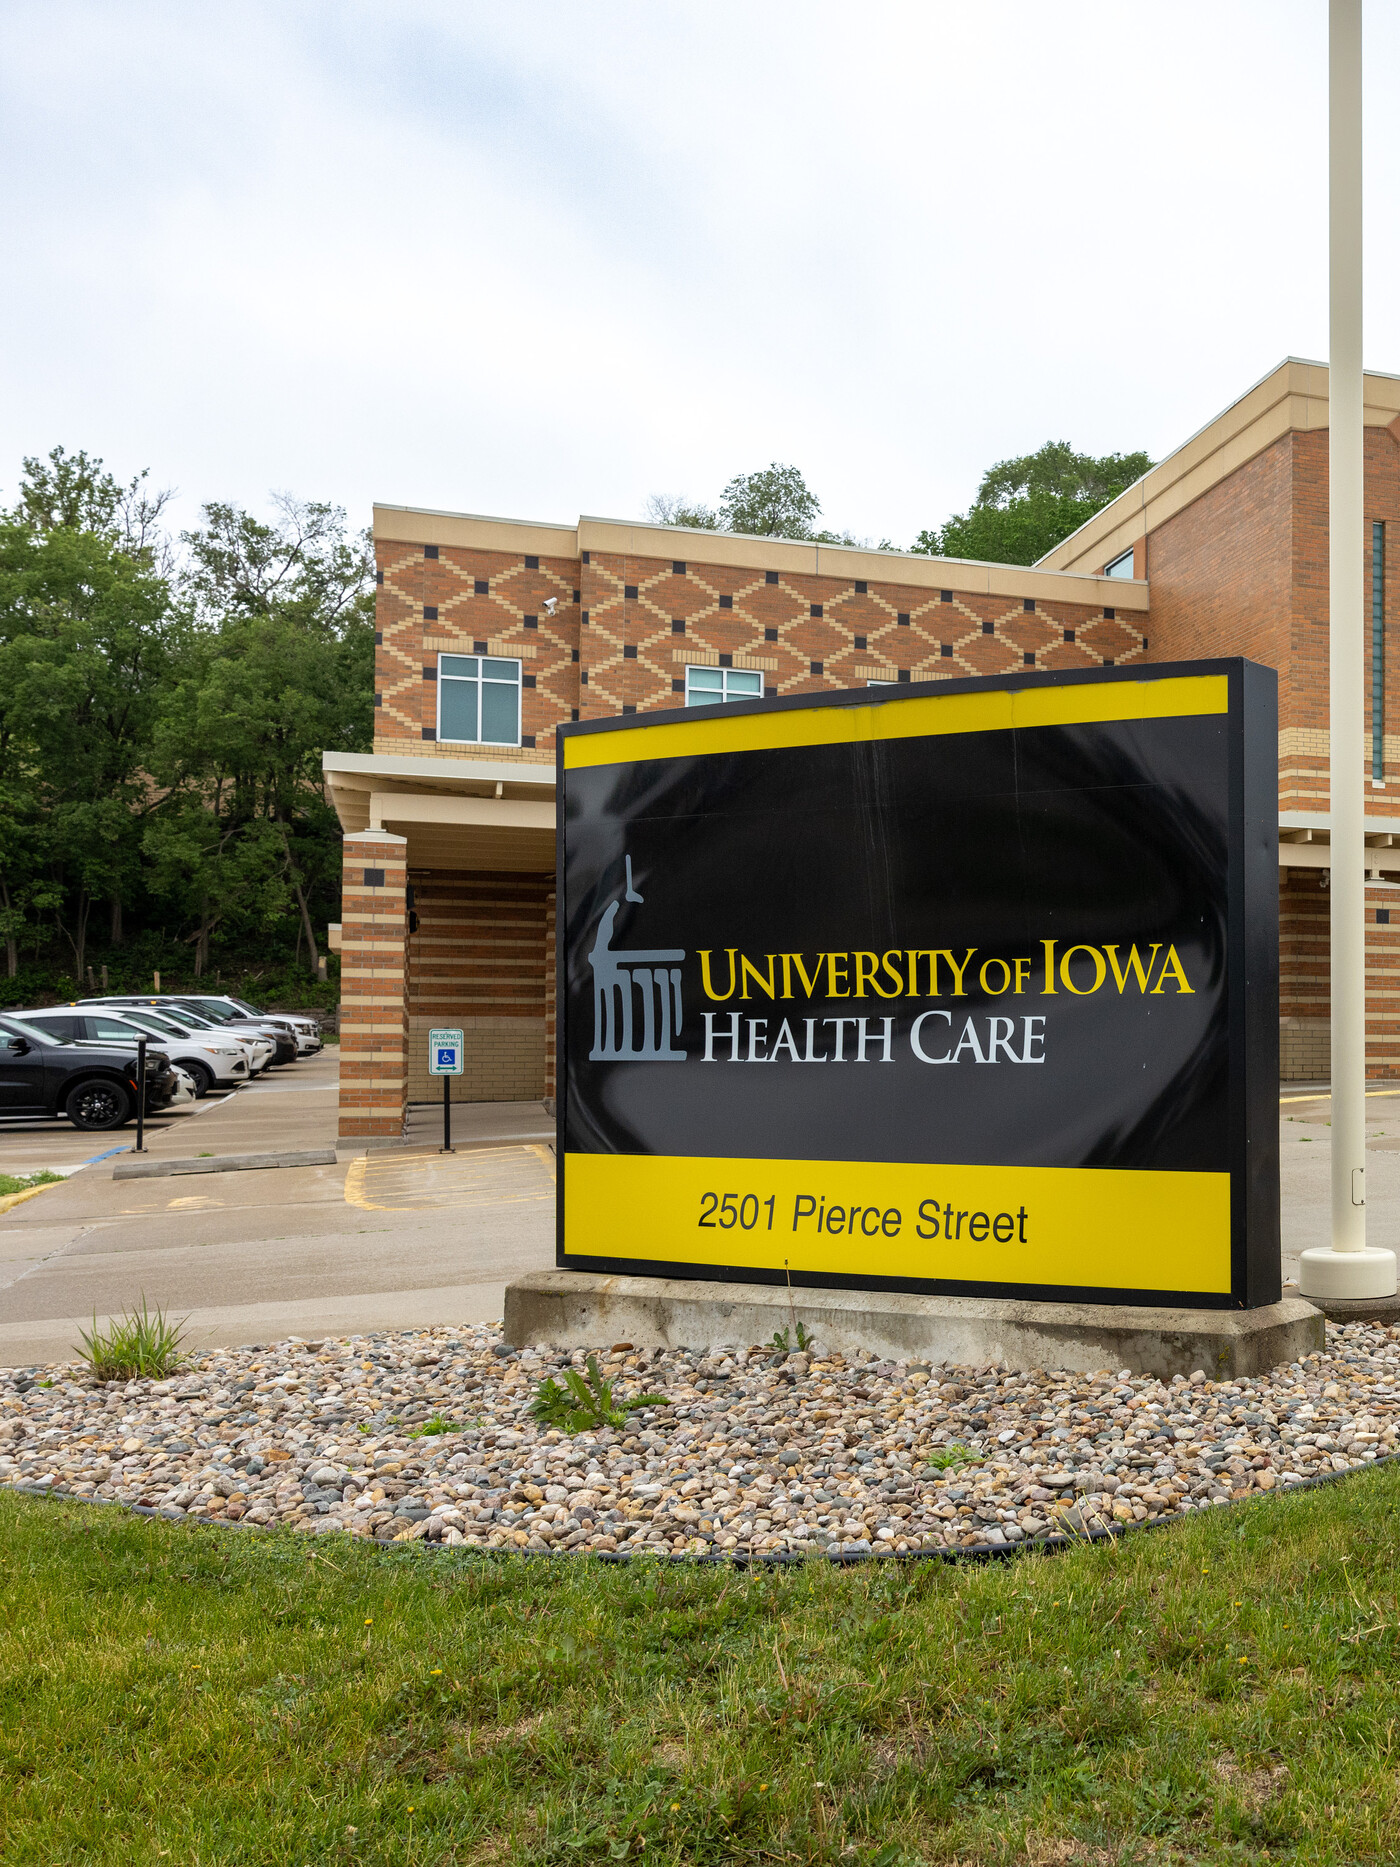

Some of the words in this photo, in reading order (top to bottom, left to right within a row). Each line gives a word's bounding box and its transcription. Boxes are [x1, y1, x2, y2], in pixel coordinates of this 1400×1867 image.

[696, 948, 977, 1000] UNIVERSITY
[979, 957, 1032, 996] OF
[1039, 939, 1196, 995] IOWA
[700, 1012, 895, 1063] HEALTH
[910, 1010, 1047, 1065] CARE
[698, 1191, 776, 1231] 2501
[792, 1194, 902, 1238] Pierce
[915, 1198, 1029, 1244] Street
